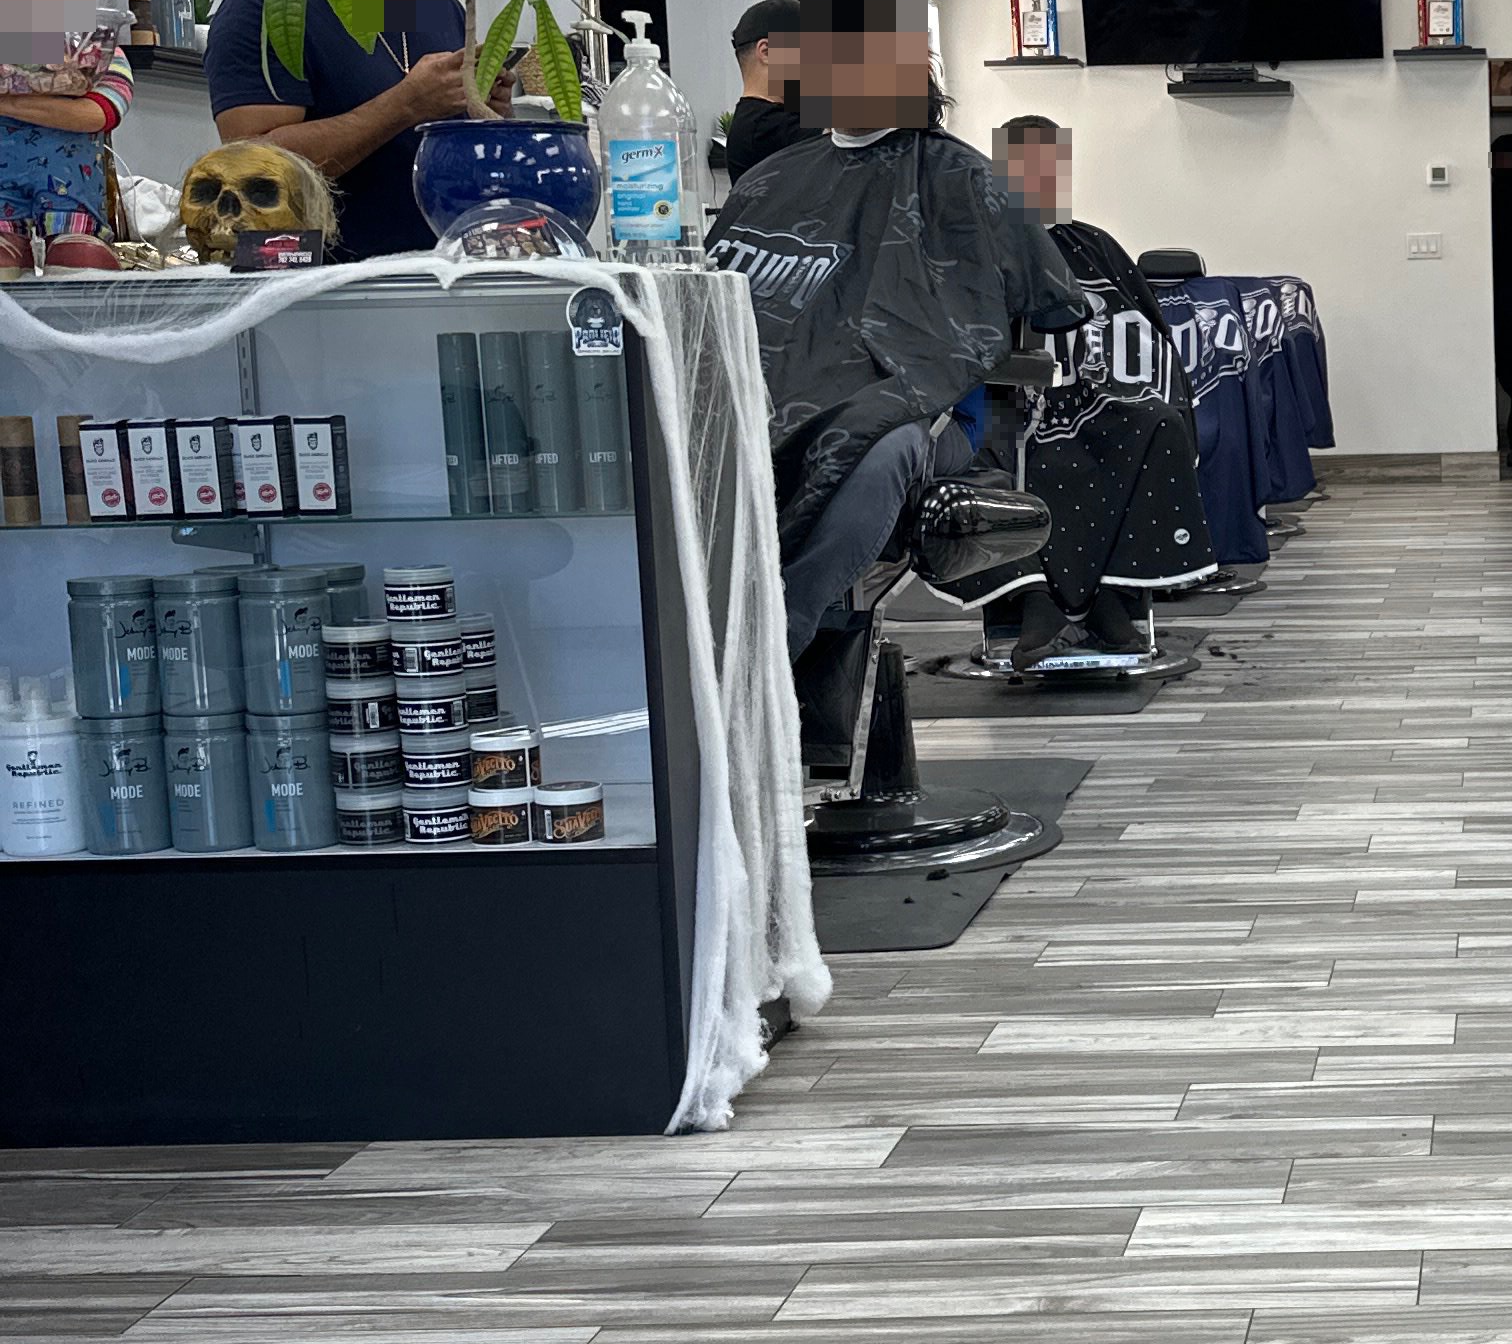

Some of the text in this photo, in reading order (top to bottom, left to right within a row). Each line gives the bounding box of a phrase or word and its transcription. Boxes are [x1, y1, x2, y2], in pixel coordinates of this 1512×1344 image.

[491, 454, 519, 465] LIFTED
[589, 452, 617, 463] LIFTED
[127, 646, 156, 661] MODE
[162, 647, 188, 661] MODE
[288, 643, 319, 659] MODE
[110, 784, 144, 800] MODE
[174, 783, 201, 798] MODE
[271, 782, 304, 797] MODE
[12, 799, 65, 809] REFINED
